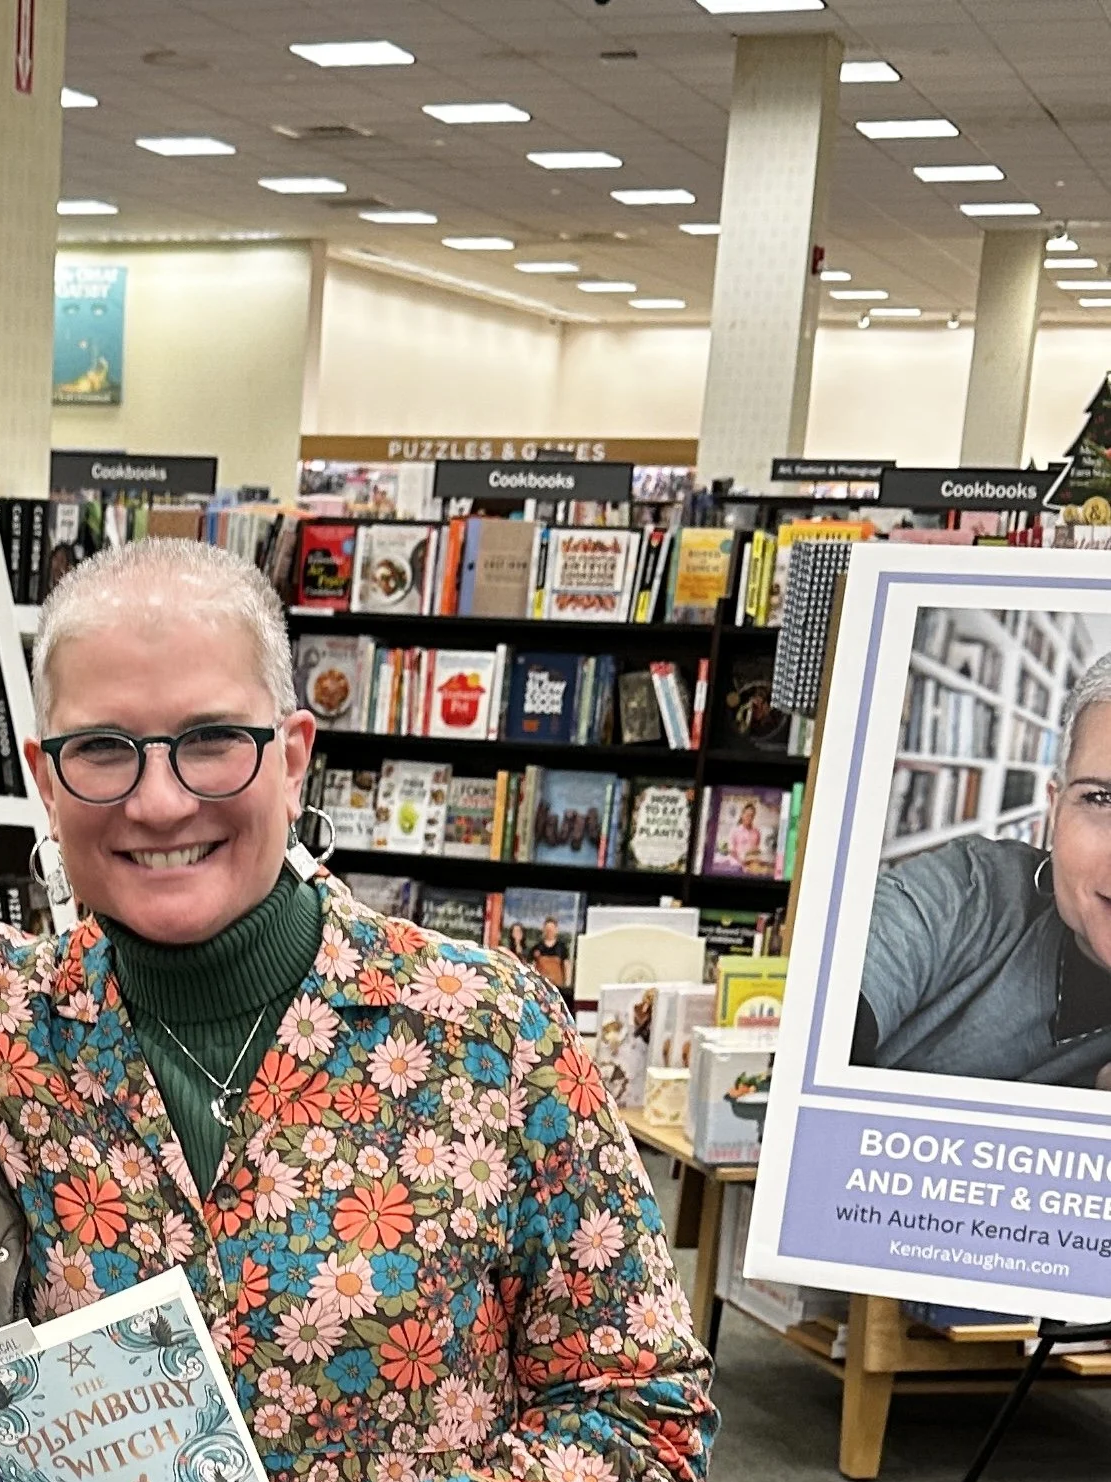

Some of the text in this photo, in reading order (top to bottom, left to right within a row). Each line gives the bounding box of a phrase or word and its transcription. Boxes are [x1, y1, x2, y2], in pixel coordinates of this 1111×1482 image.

[388, 440, 492, 461] PUZZLES
[501, 442, 515, 461] &
[92, 462, 167, 482] Cookbooks
[489, 471, 575, 490] Cookbooks
[941, 480, 1038, 499] Cookbooks
[859, 1128, 1111, 1184] BOOK SIGNIN
[845, 1168, 1111, 1221] AND MEET & GREE
[836, 1204, 1111, 1258] with Author Kendra Vaug
[889, 1240, 1070, 1278] KendraVaughan.com
[71, 1376, 109, 1398] THE
[16, 1378, 198, 1472] PLYMBURY
[52, 1418, 183, 1481] WITCH
